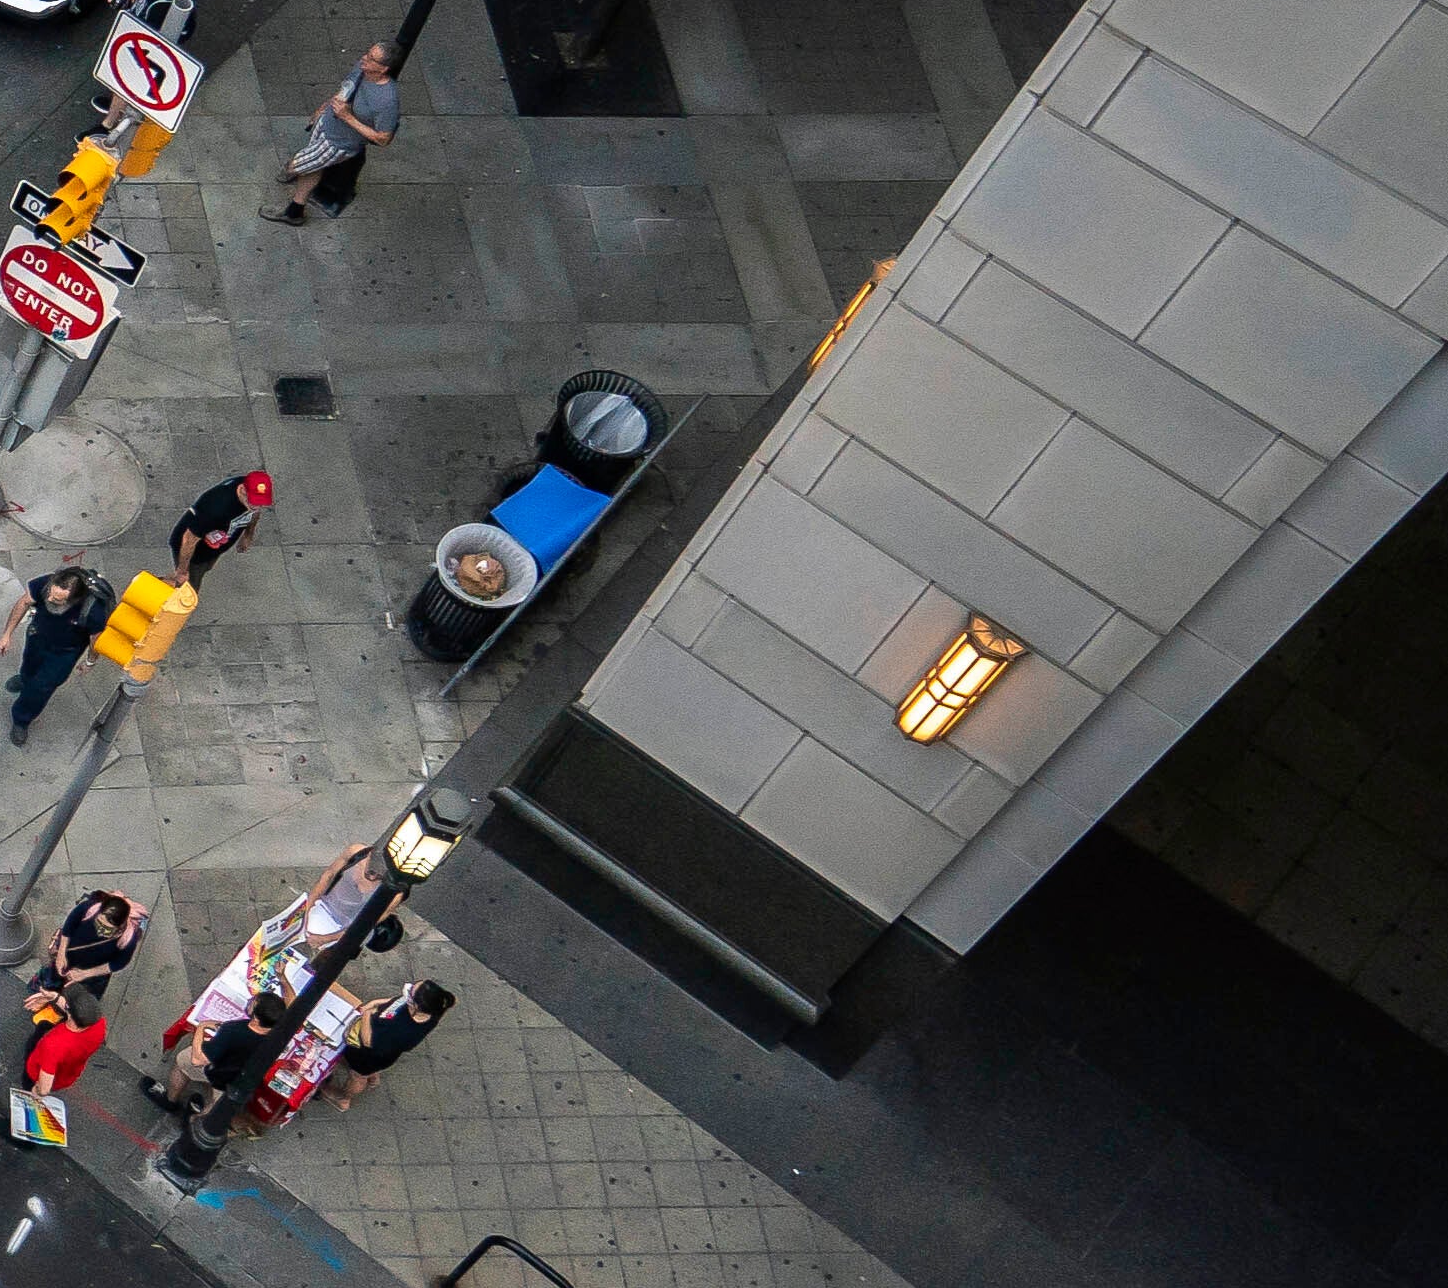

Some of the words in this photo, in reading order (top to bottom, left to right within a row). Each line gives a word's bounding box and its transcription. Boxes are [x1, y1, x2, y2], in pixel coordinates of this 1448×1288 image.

[21, 251, 48, 272] DO
[57, 271, 97, 303] NOT
[13, 285, 72, 334] ENTER
